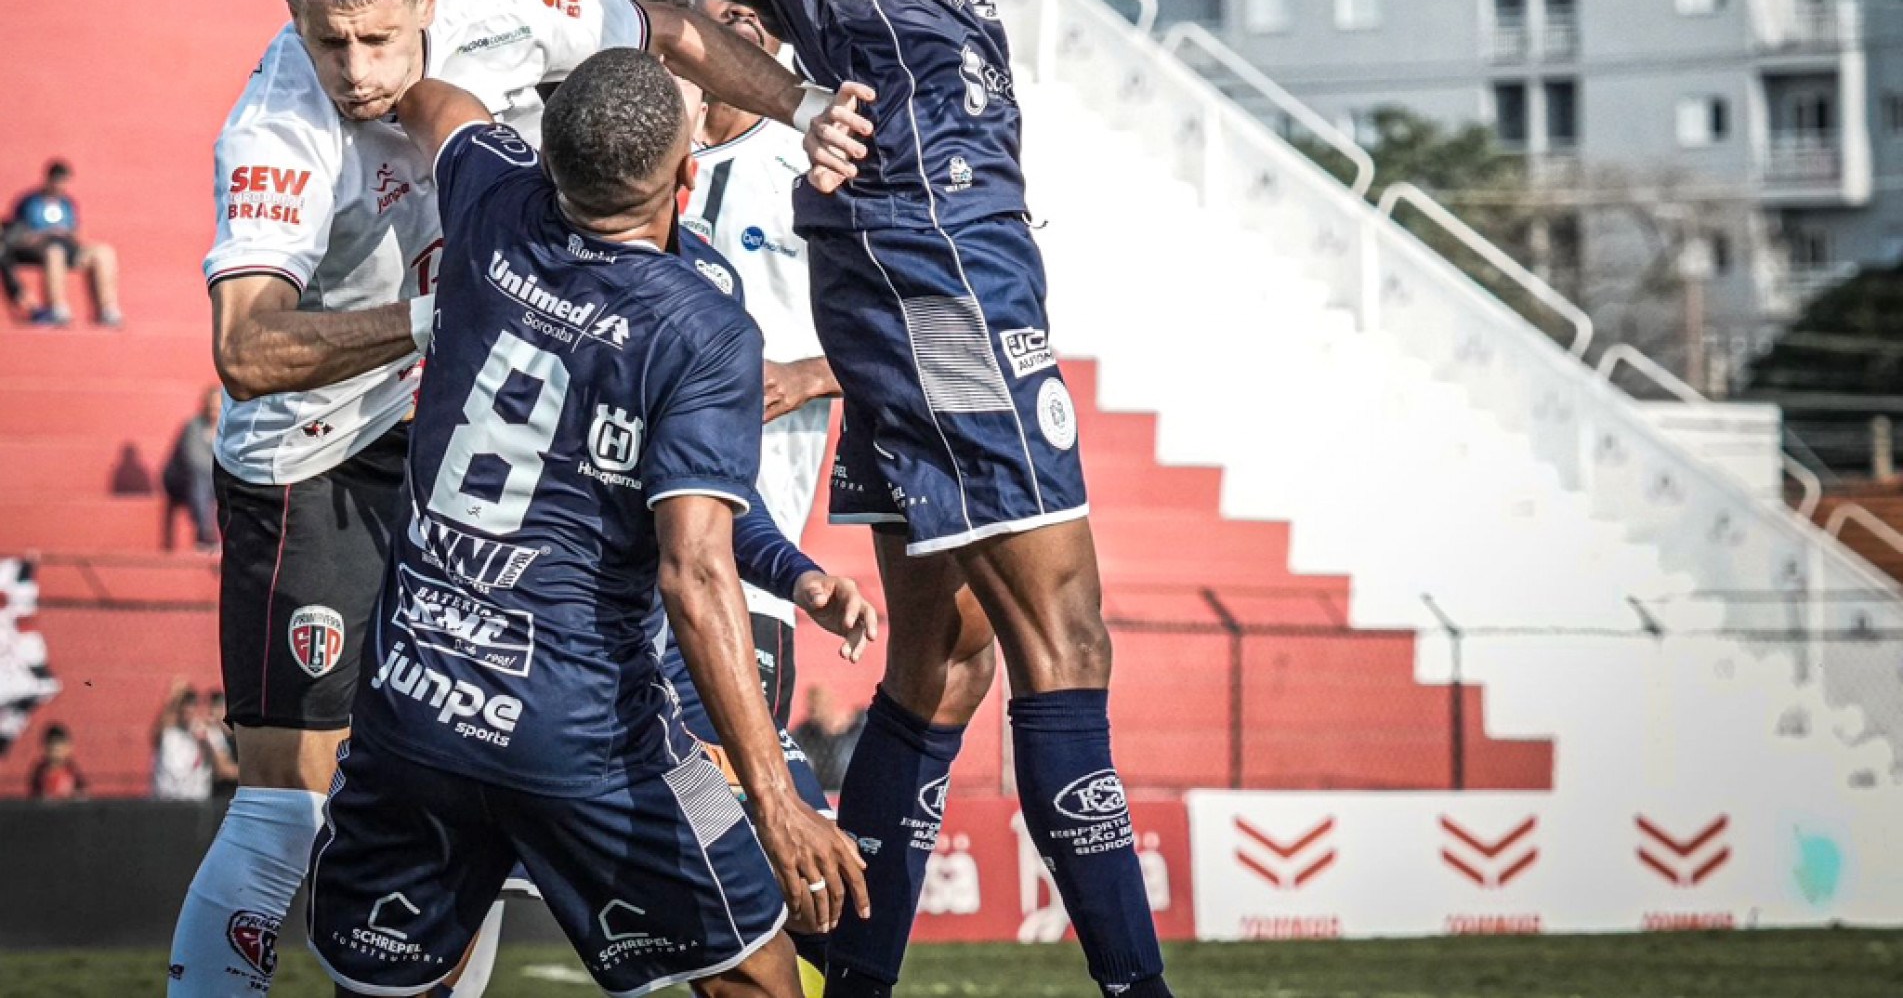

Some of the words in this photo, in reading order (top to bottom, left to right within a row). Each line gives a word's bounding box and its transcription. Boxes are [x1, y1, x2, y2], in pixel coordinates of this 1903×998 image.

[230, 166, 312, 196] SEW
[228, 202, 300, 225] BRASIL
[488, 250, 596, 326] Unimed
[427, 329, 570, 536] 8
[371, 641, 523, 733] junpe
[455, 722, 511, 748] sports
[352, 928, 422, 954] SCHREPEL
[600, 937, 673, 962] SCHREPEL
